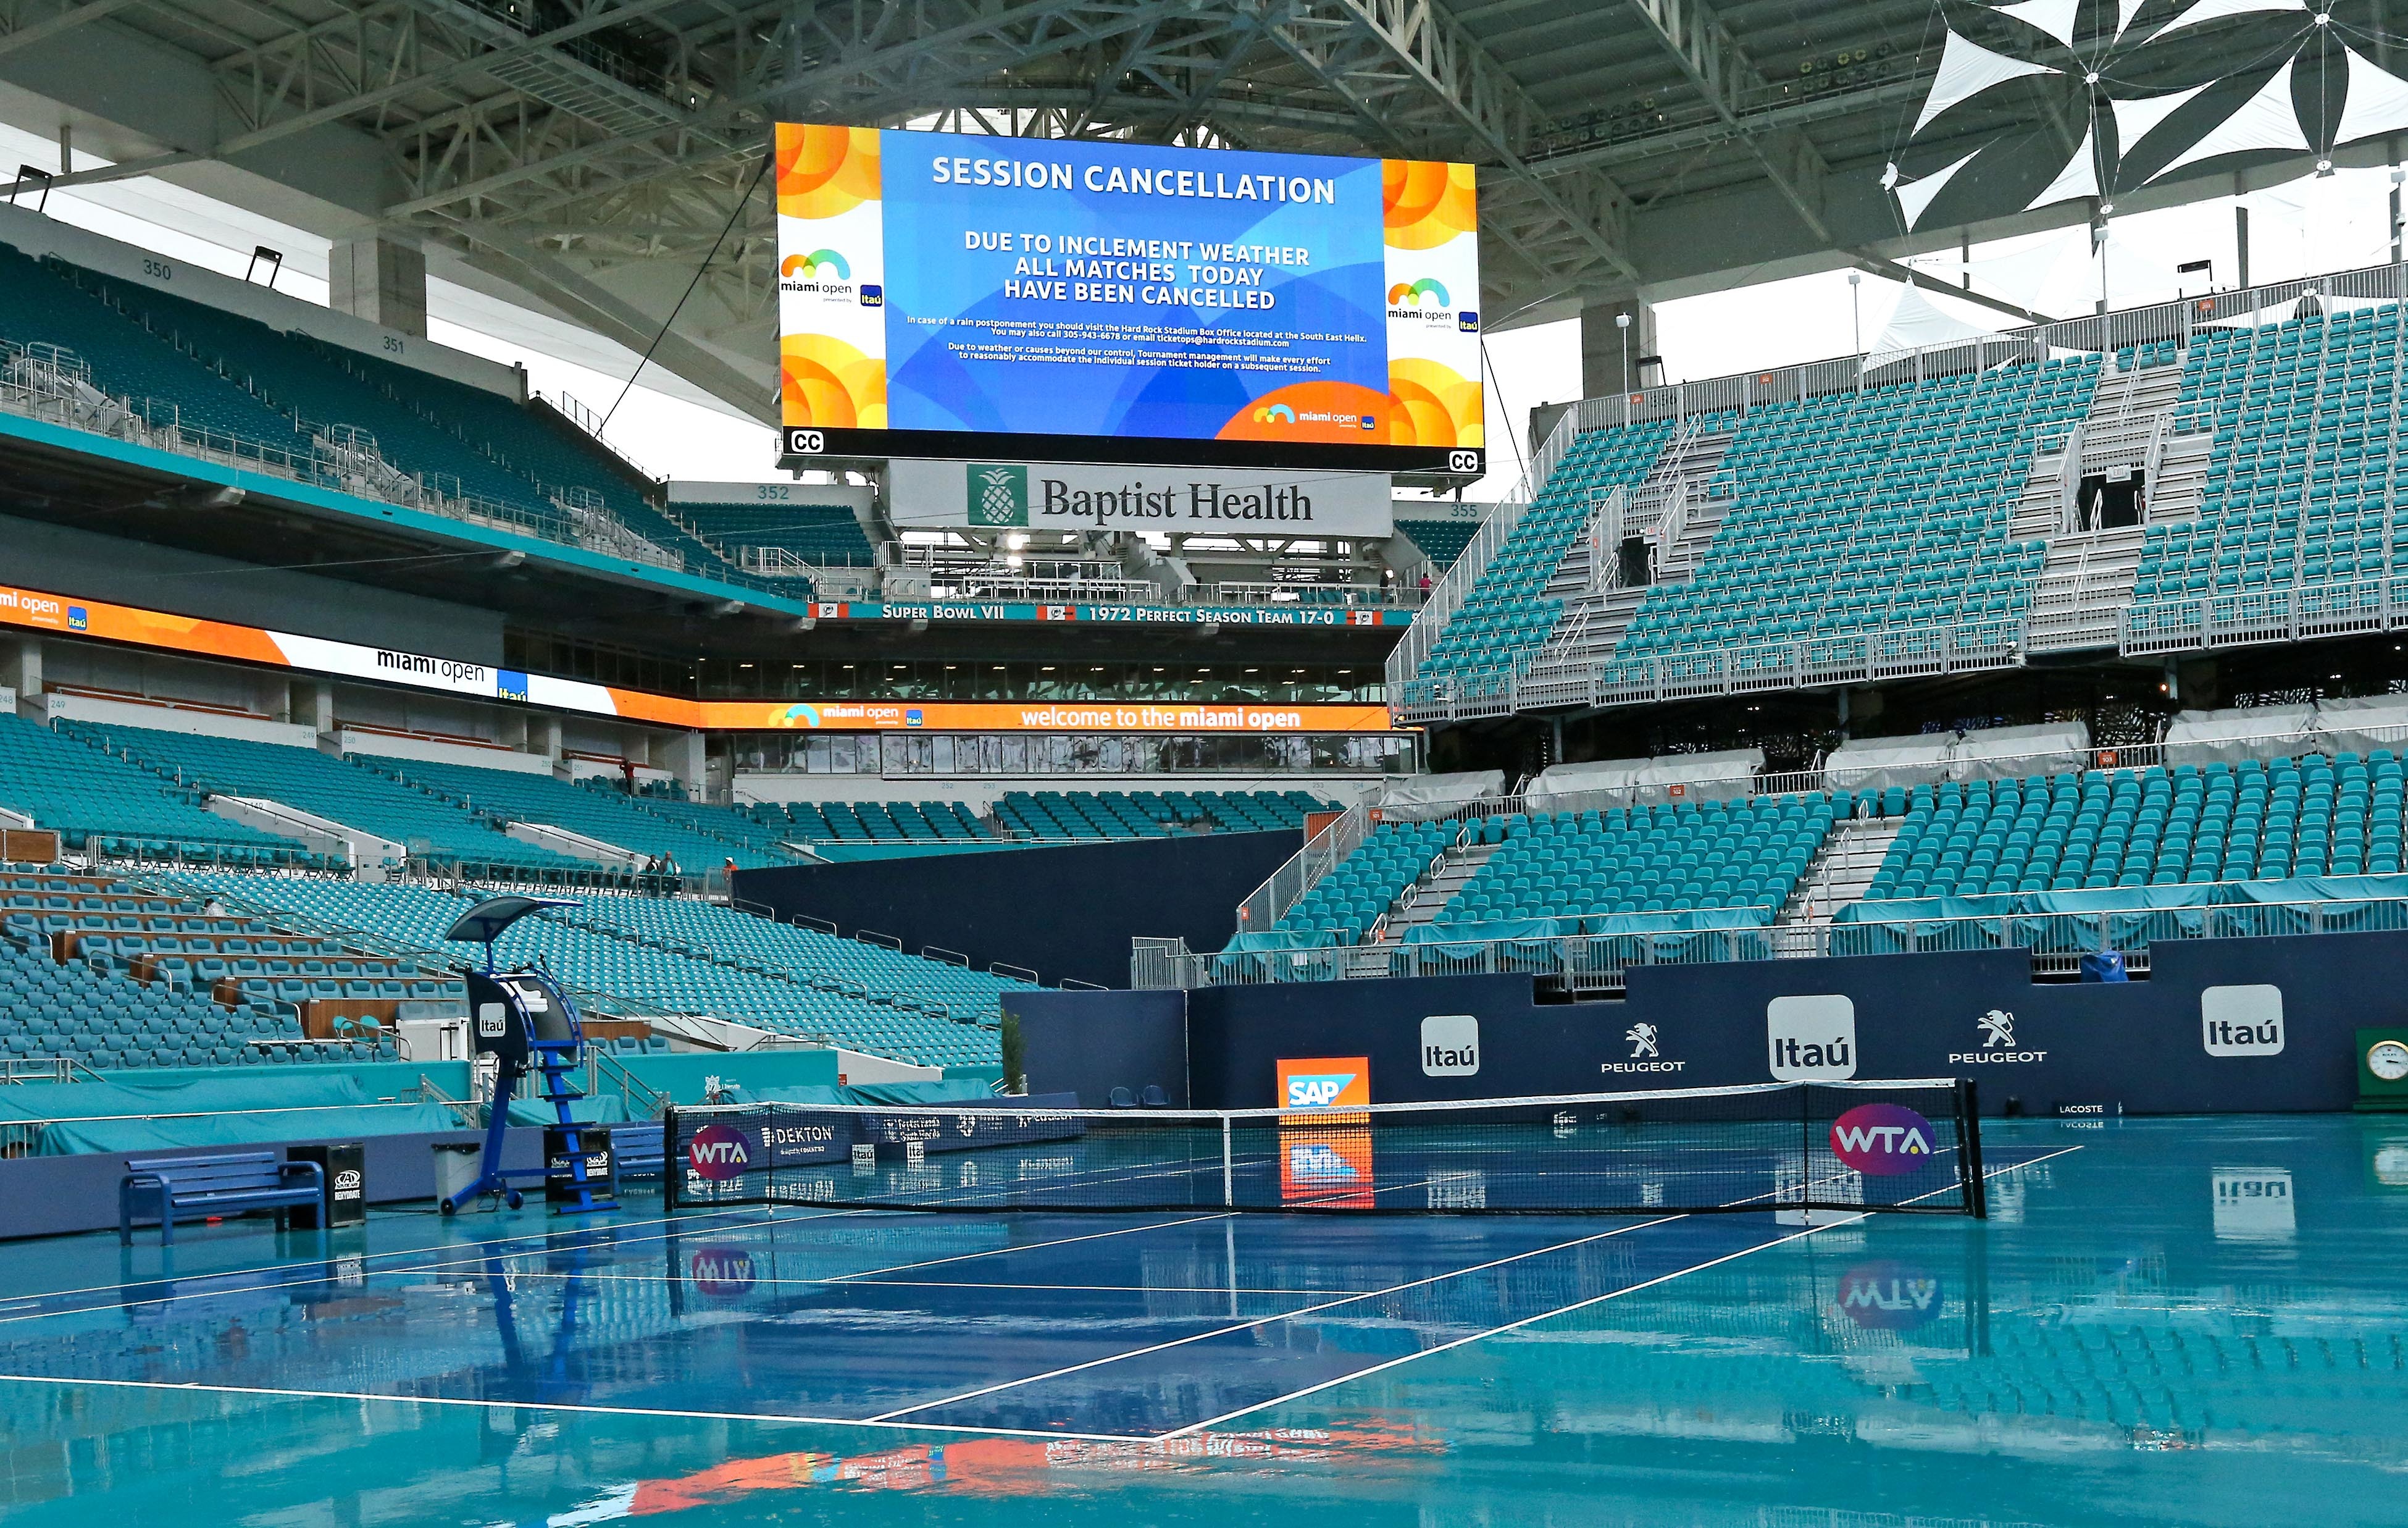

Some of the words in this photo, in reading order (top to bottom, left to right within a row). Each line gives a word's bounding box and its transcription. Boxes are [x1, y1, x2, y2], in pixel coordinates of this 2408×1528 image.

[934, 157, 1072, 189] SESSION
[1085, 166, 1334, 203] CANCELLATION
[965, 231, 1013, 251] DUE
[1019, 234, 1051, 252] TO
[1059, 236, 1193, 259] INCLEMENT
[1199, 243, 1310, 266] WEATHER
[143, 259, 171, 280] 350
[1014, 257, 1058, 276] ALL
[1066, 259, 1175, 282] MATCHES
[1187, 266, 1263, 286] TODAY
[781, 281, 819, 292] miami
[822, 284, 851, 295] open
[1005, 280, 1067, 300] HAVE
[1075, 283, 1134, 303] BEEN
[1142, 287, 1275, 309] CANCELLED
[861, 295, 881, 304] Itaú
[1389, 309, 1422, 319] miami
[1425, 312, 1451, 321] open
[976, 319, 1036, 329] postponement
[1056, 322, 1083, 330] should
[1121, 325, 1141, 333] Hard
[1164, 327, 1197, 335] Stadium
[1216, 329, 1242, 337] Office
[1244, 330, 1273, 338] located
[1326, 334, 1342, 342] East
[1460, 321, 1478, 330] Itaú
[383, 336, 404, 354] 351
[1064, 331, 1120, 340] 305-943-6678
[1157, 335, 1289, 347] ticketops@hardrockstadium.com
[978, 344, 1012, 352] weather
[1055, 347, 1085, 356] beyond
[1103, 349, 1135, 358] control,
[1138, 350, 1186, 359] Tournament
[971, 353, 1016, 362] reasonably
[1019, 355, 1076, 363] accommodate
[1094, 357, 1135, 365] individual
[1169, 359, 1192, 367] ticket
[1194, 361, 1219, 369] holder
[1242, 363, 1287, 372] subsequent
[1299, 411, 1330, 421] miami
[1332, 415, 1357, 424] open
[794, 434, 821, 450] CC
[1452, 453, 1476, 469] CC
[758, 485, 788, 500] 352
[1041, 480, 1177, 526] Baptist
[1188, 484, 1313, 520] Health
[1450, 505, 1478, 518] 355
[21, 597, 59, 614] open
[882, 605, 927, 618] SUPER
[933, 605, 977, 618] BOWL
[982, 606, 1003, 619] VII
[69, 617, 86, 628] Itaú
[1090, 607, 1131, 621] 1972
[1137, 607, 1192, 623] PERFECT
[1197, 608, 1252, 624] SEASON
[1257, 610, 1292, 624] TEAM
[1300, 610, 1334, 625] 17-0
[377, 651, 435, 674] miami
[441, 661, 484, 682] open
[51, 700, 65, 708] 249
[823, 705, 864, 717] miami
[867, 708, 898, 719] open
[1022, 707, 1111, 726] welcome
[1116, 710, 1137, 726] to
[1142, 708, 1175, 726] the
[1180, 708, 1244, 727] miami
[1248, 713, 1300, 731] open
[482, 1019, 504, 1031] Itaú
[2209, 1020, 2278, 1045] Itaú
[1426, 1046, 1474, 1067] Itaú
[1776, 1037, 1849, 1067] Itaú
[1949, 1052, 2047, 1063] PEUGEOT
[1602, 1062, 1685, 1072] PEUGEOT
[1289, 1081, 1339, 1106] SAP
[776, 1126, 832, 1143] DEKTON
[1836, 1126, 1929, 1154] WTA
[692, 1143, 748, 1163] WTA
